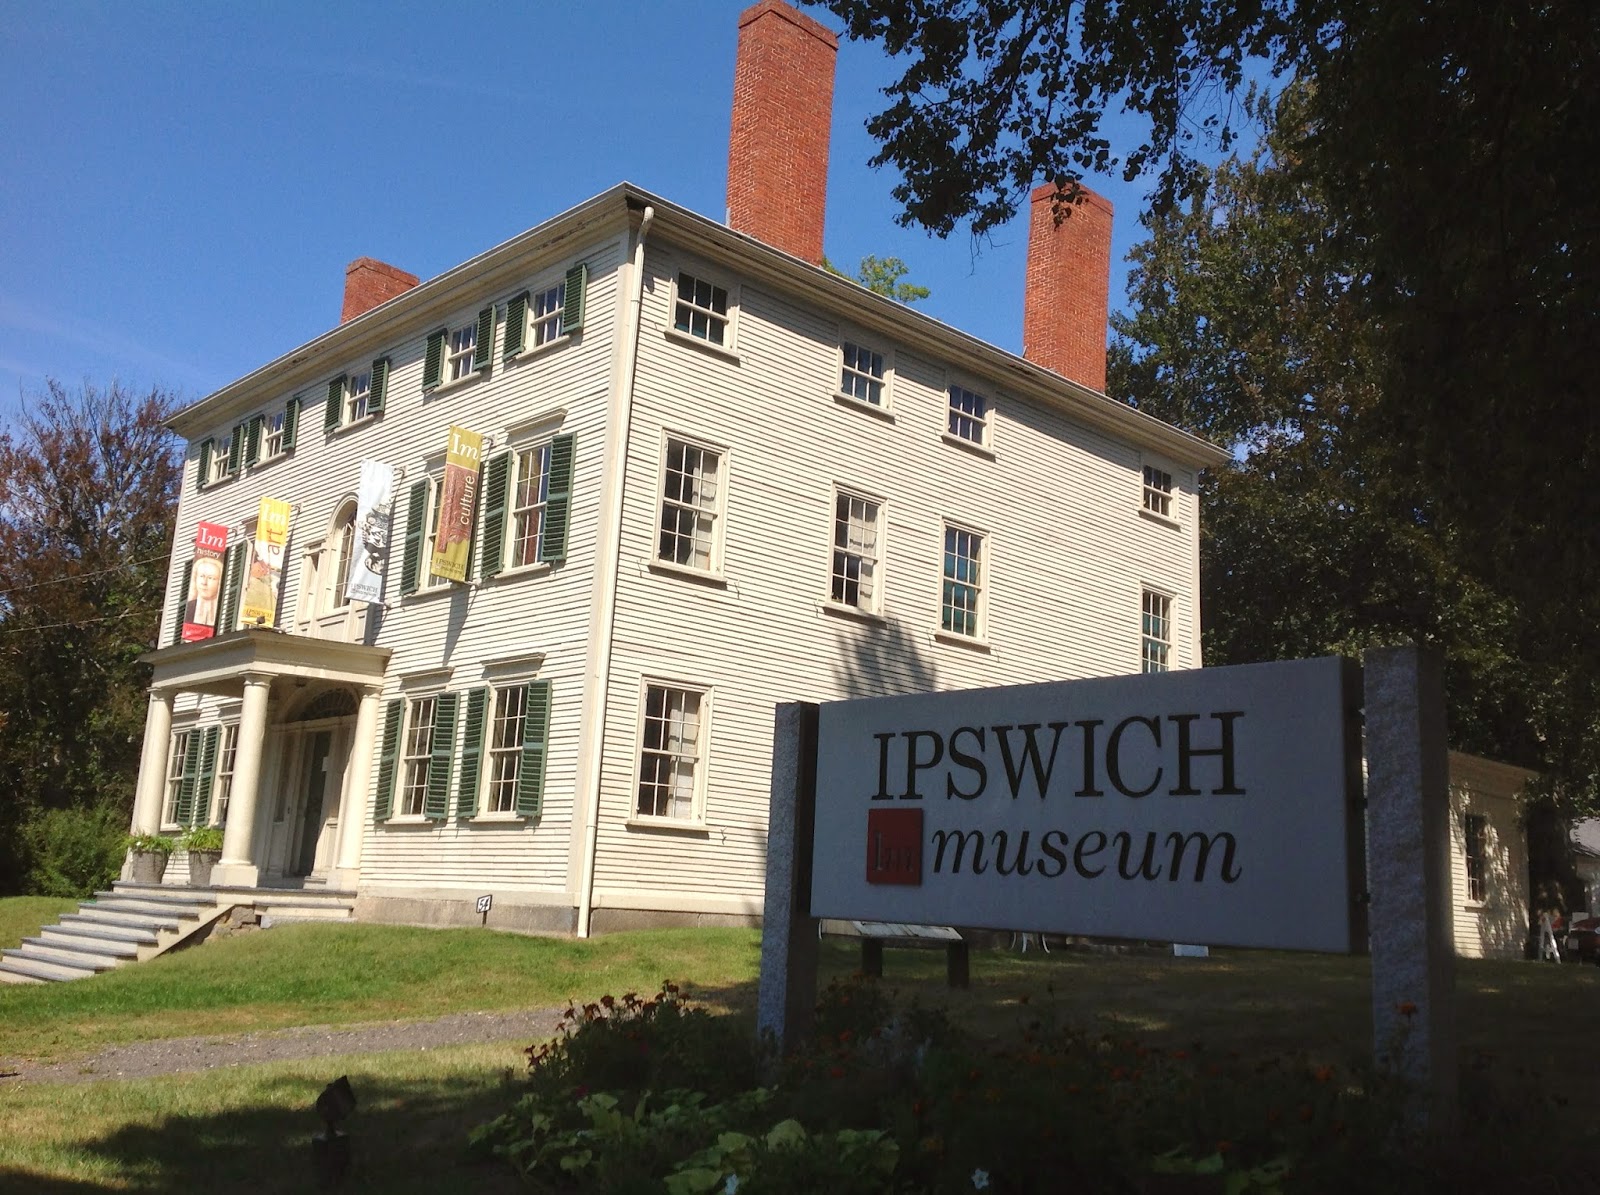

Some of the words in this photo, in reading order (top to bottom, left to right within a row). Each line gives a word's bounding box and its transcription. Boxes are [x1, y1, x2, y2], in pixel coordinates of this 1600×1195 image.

[450, 432, 479, 460] Im
[460, 475, 475, 525] culture
[200, 527, 224, 548] Im
[266, 528, 283, 555] art
[197, 547, 221, 559] history
[871, 711, 1247, 801] IPSWICH
[931, 827, 1243, 884] museum
[479, 898, 490, 911] 54
